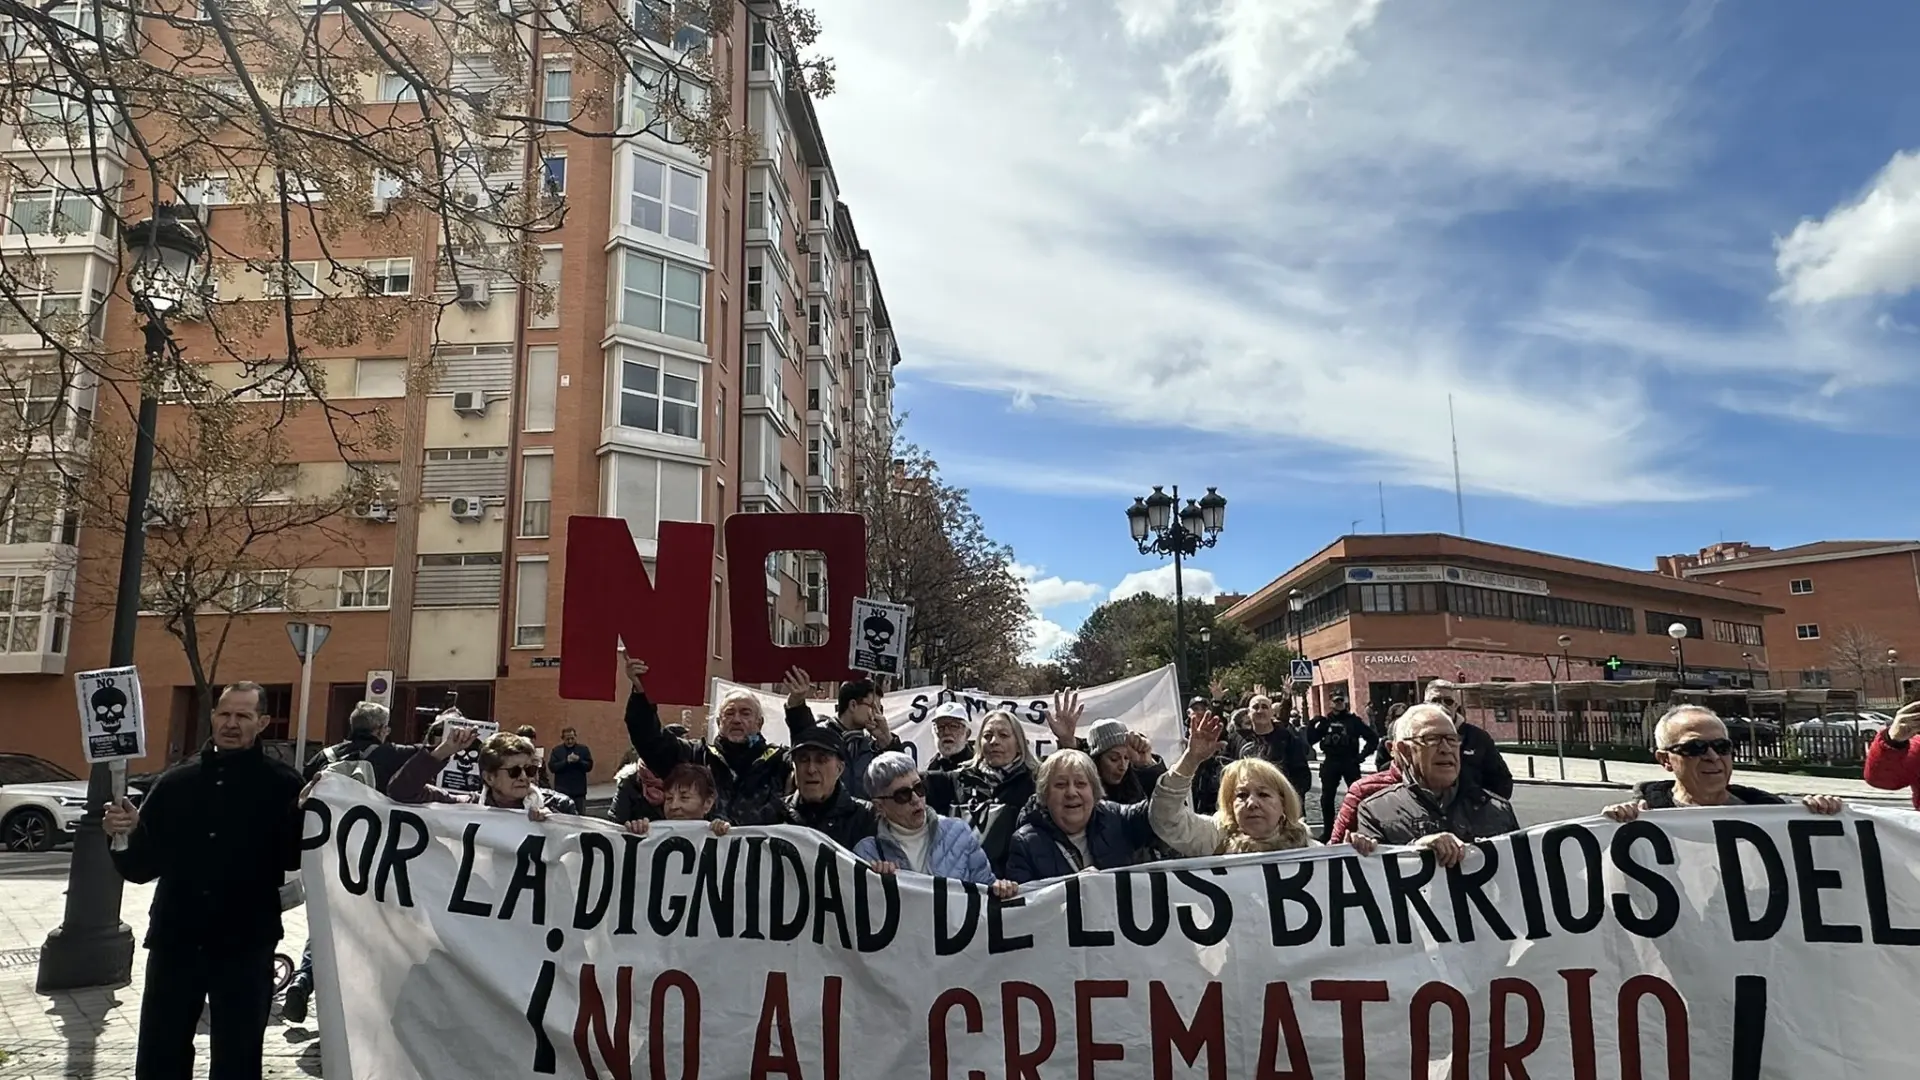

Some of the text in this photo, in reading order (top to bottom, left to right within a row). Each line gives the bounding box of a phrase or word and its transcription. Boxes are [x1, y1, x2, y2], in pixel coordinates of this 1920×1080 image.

[559, 512, 866, 706] NO
[870, 608, 887, 618] NO
[1364, 655, 1418, 664] FARMACIA
[96, 677, 115, 689] NO
[302, 797, 1920, 956] POR LA DIGNIDAD DE LOS BARRIOS DEL
